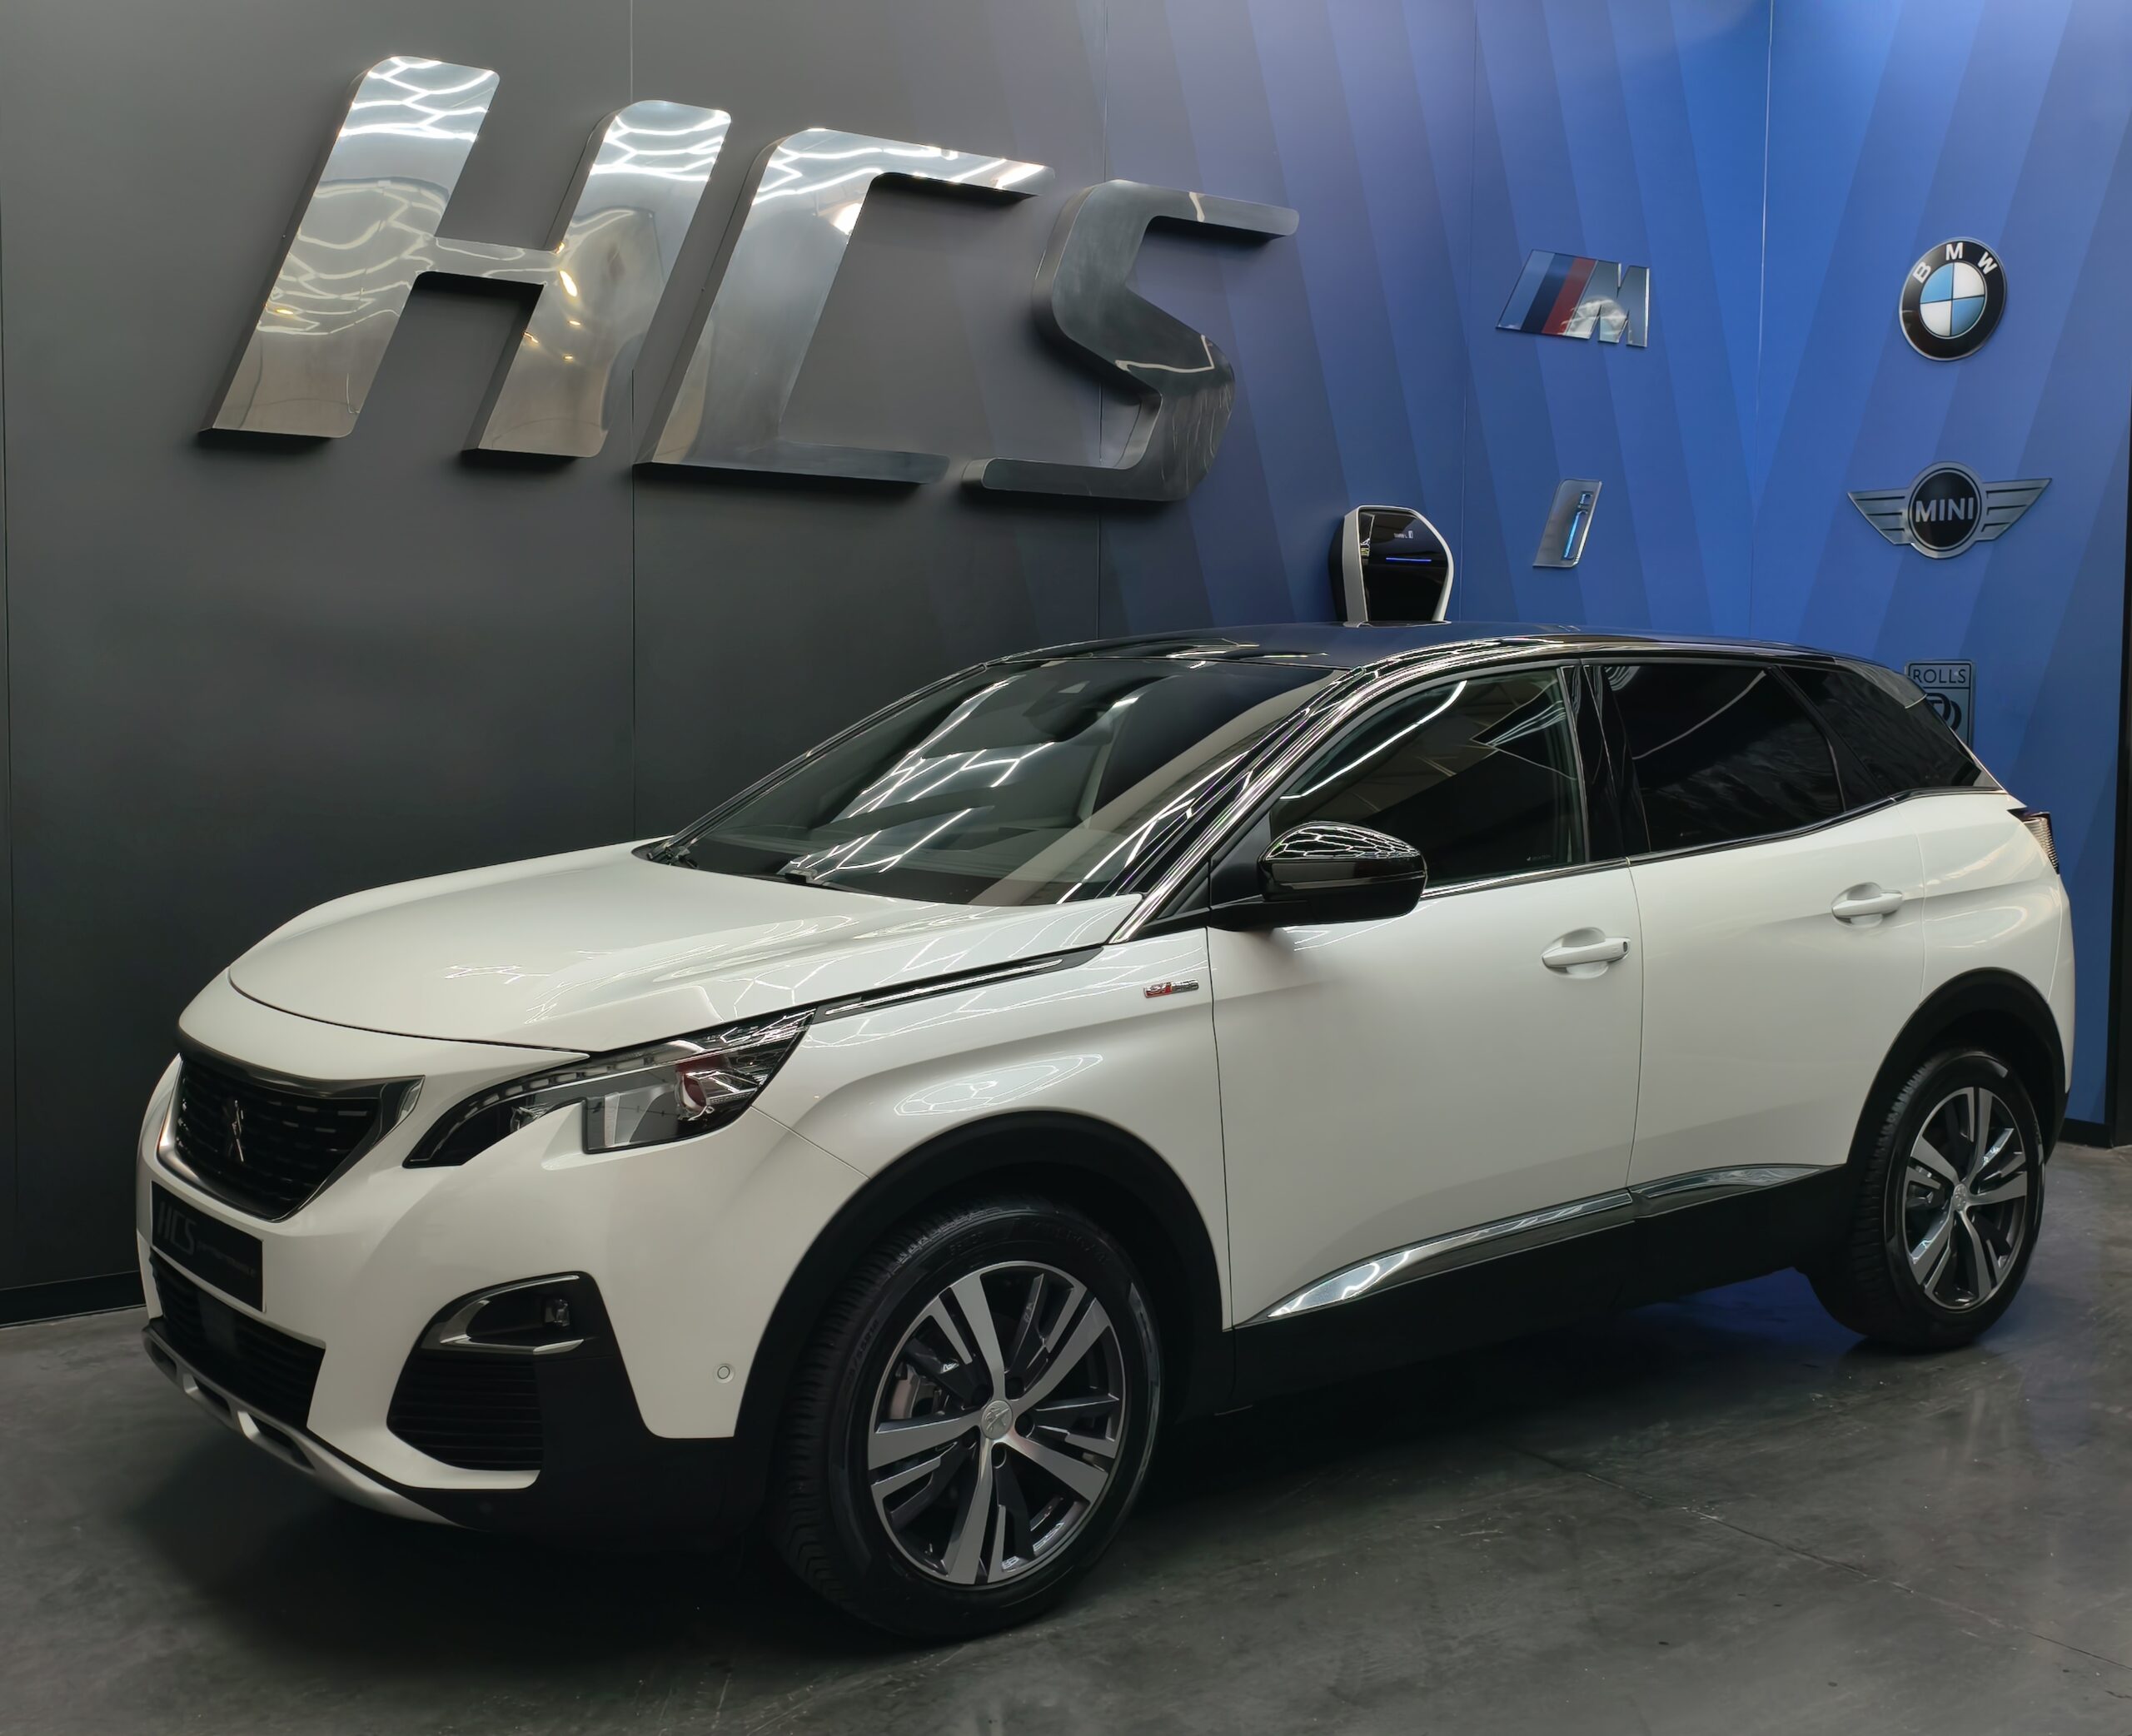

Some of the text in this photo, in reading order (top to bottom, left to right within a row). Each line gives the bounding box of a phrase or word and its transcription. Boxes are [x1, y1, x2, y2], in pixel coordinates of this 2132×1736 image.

[198, 55, 1300, 502] HCS
[1912, 241, 1998, 284] BMW
[1562, 258, 1651, 348] M
[1915, 497, 1974, 523] MINI
[1912, 668, 1966, 684] ROLLS
